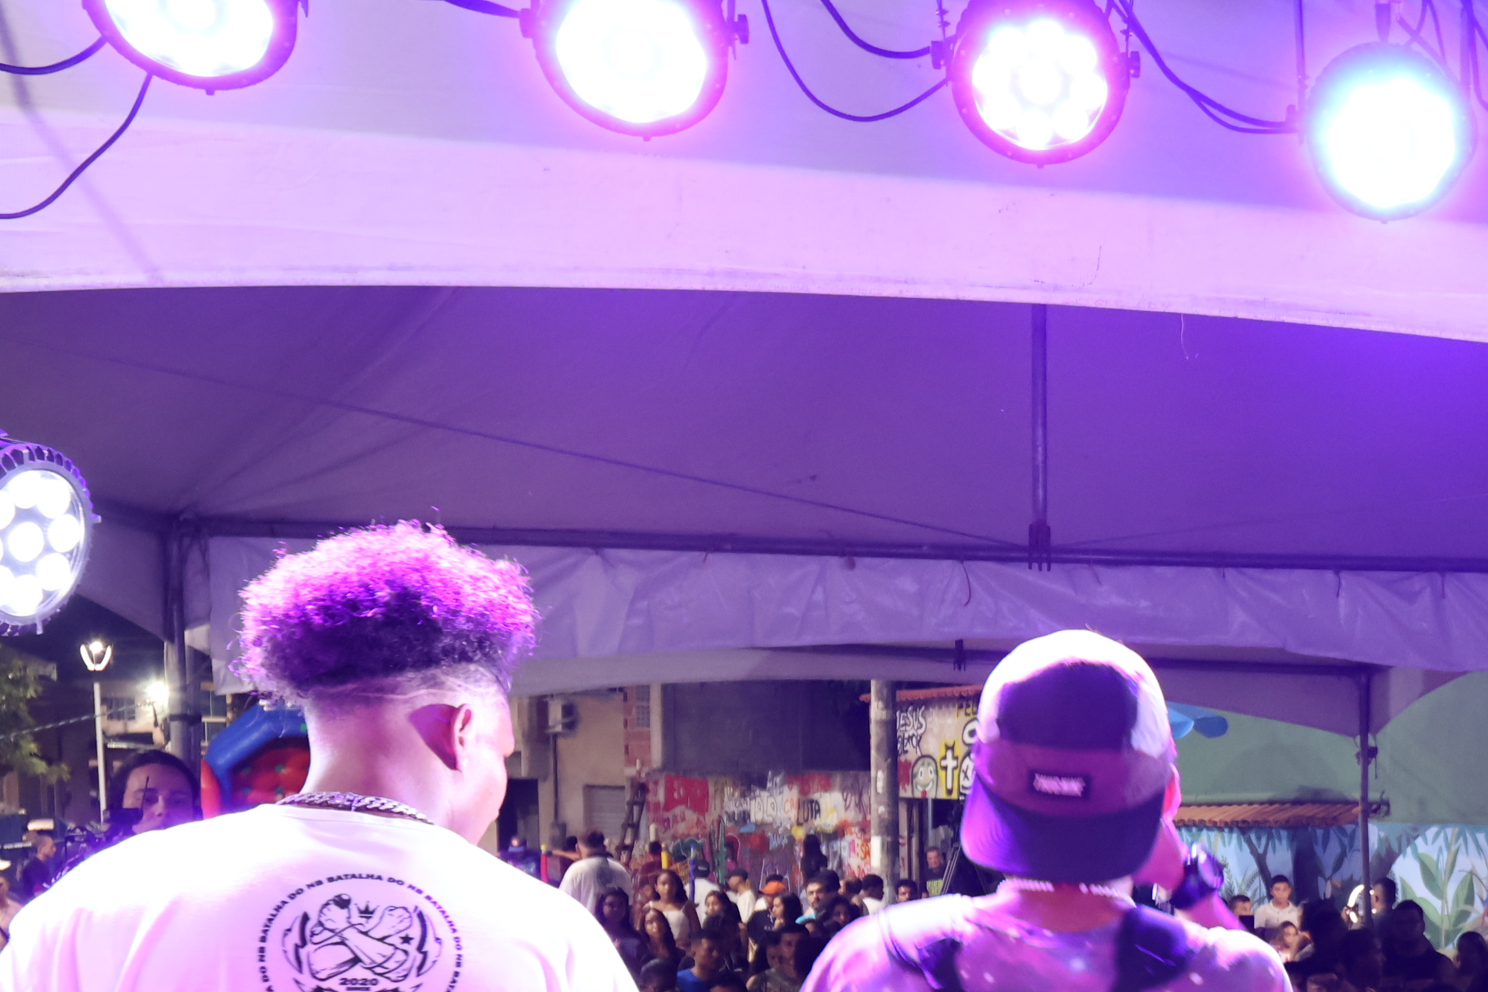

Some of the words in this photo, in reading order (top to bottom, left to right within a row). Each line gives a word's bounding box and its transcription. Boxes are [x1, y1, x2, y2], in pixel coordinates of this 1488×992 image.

[326, 873, 383, 883] BATALHA
[387, 877, 405, 886] DO
[287, 888, 304, 900] DO
[425, 895, 457, 934] BATALHA
[259, 900, 289, 943] BATALHA
[453, 936, 463, 951] DO
[260, 966, 269, 983] DO
[339, 977, 379, 986] 2020
